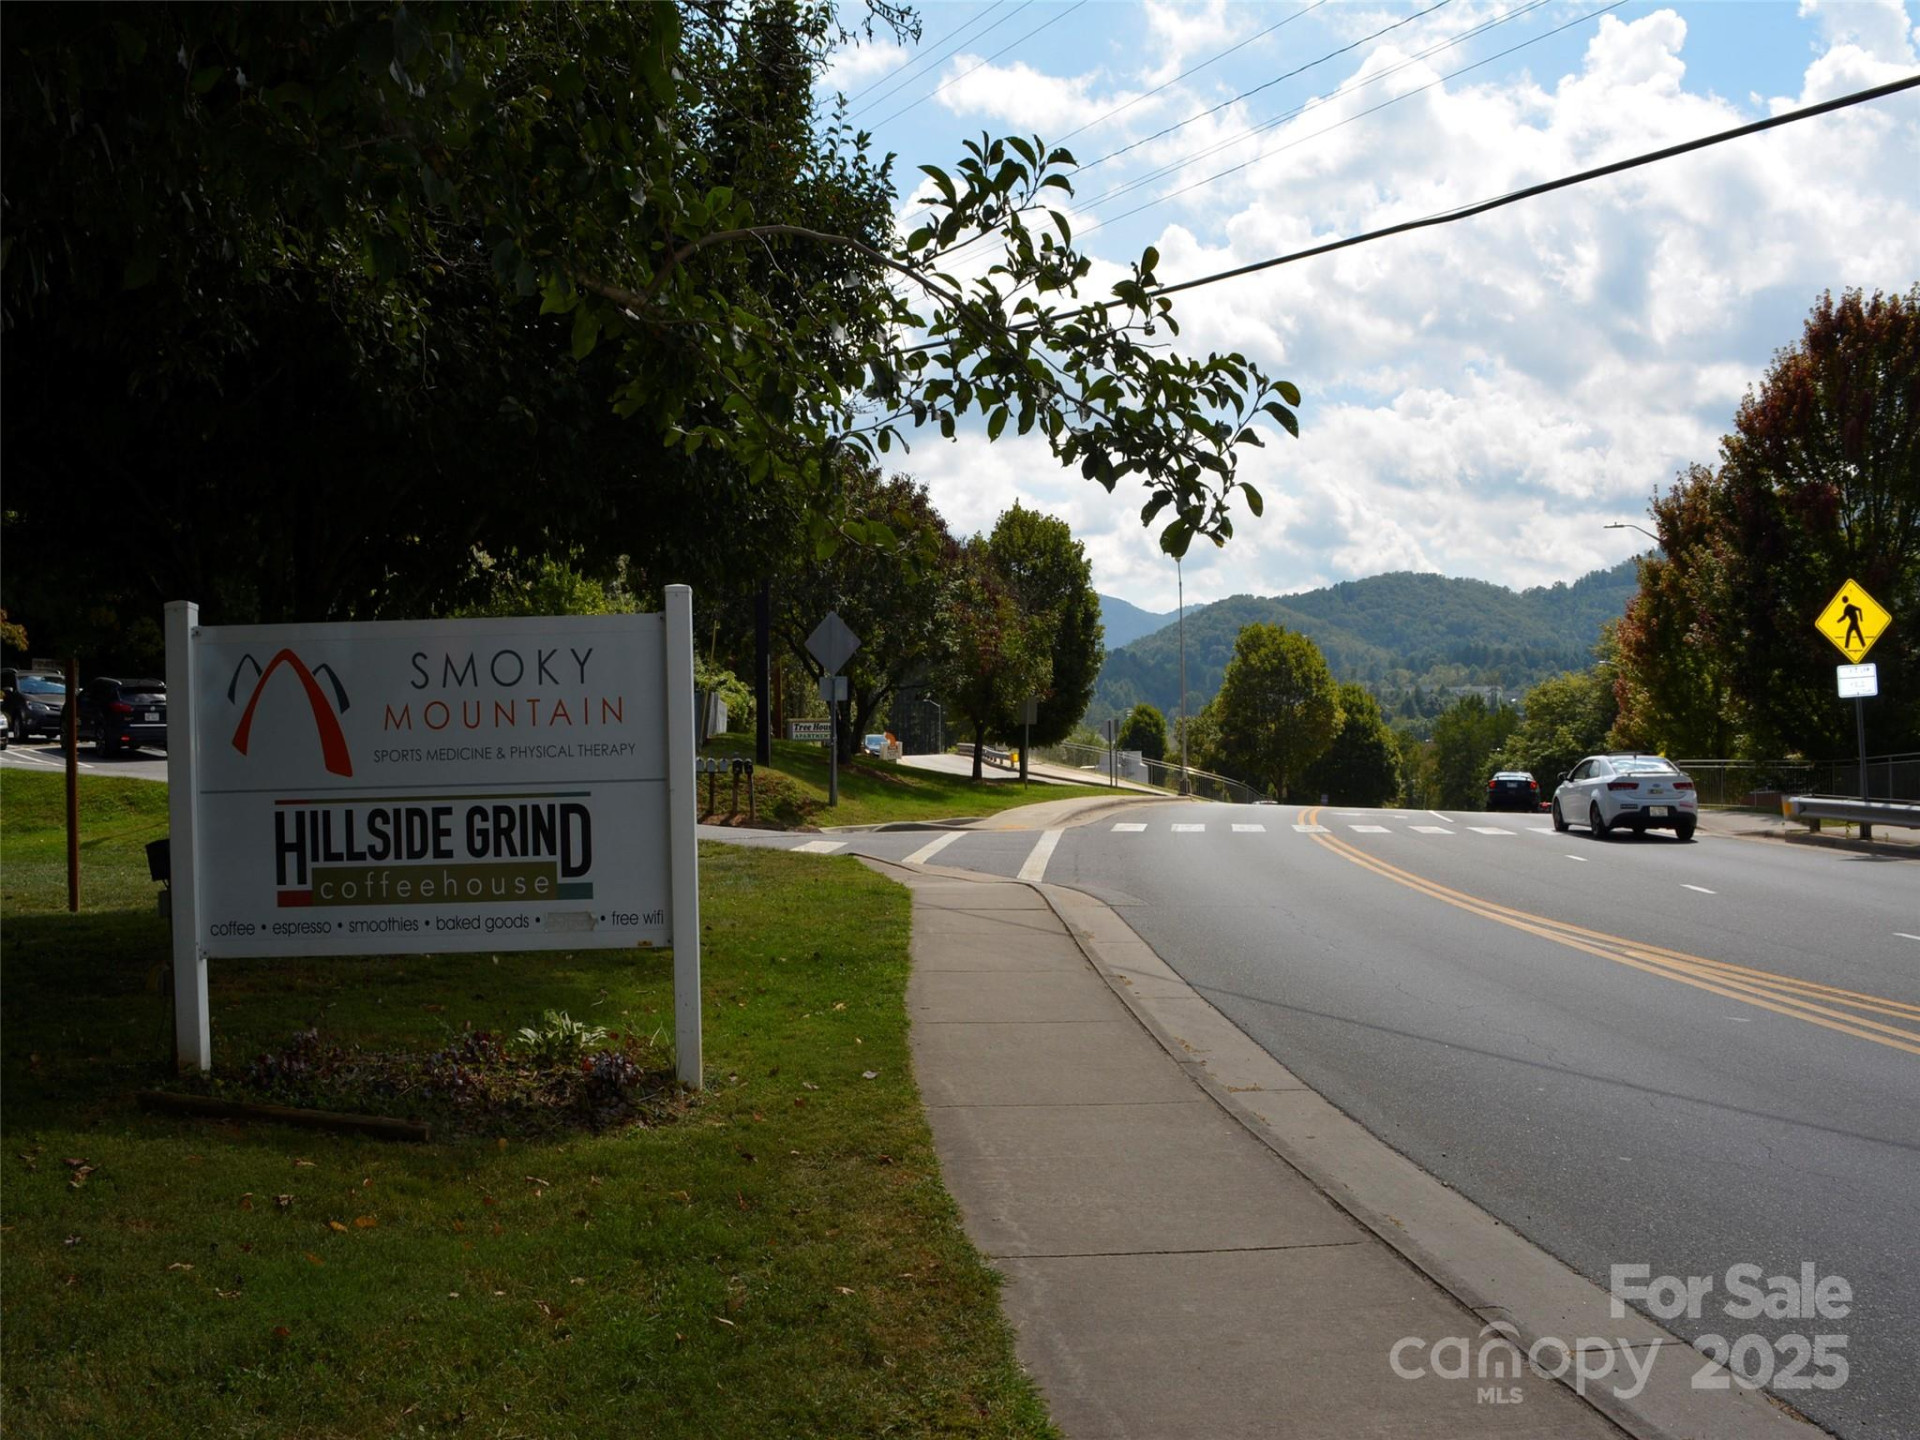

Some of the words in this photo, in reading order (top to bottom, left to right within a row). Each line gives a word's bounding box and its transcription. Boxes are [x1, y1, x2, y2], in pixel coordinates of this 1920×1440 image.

[410, 648, 593, 690] SMOKY
[384, 697, 623, 731] MOUNTAIN
[794, 723, 812, 731] Tree
[373, 748, 422, 764] SPORTS
[426, 746, 492, 762] MEDICINE
[496, 747, 506, 760] &
[510, 744, 574, 759] PHYSICAL
[577, 743, 636, 757] THERAPY
[274, 806, 454, 885] HILLSIDE
[466, 803, 591, 877] GRIND
[320, 869, 550, 899] coffeehouse
[210, 920, 256, 937] coffee
[272, 920, 332, 937] espresso
[349, 917, 420, 933] smoothies
[436, 915, 481, 931] baked
[484, 913, 530, 933] goods
[611, 911, 640, 926] free
[642, 909, 665, 925] wifi
